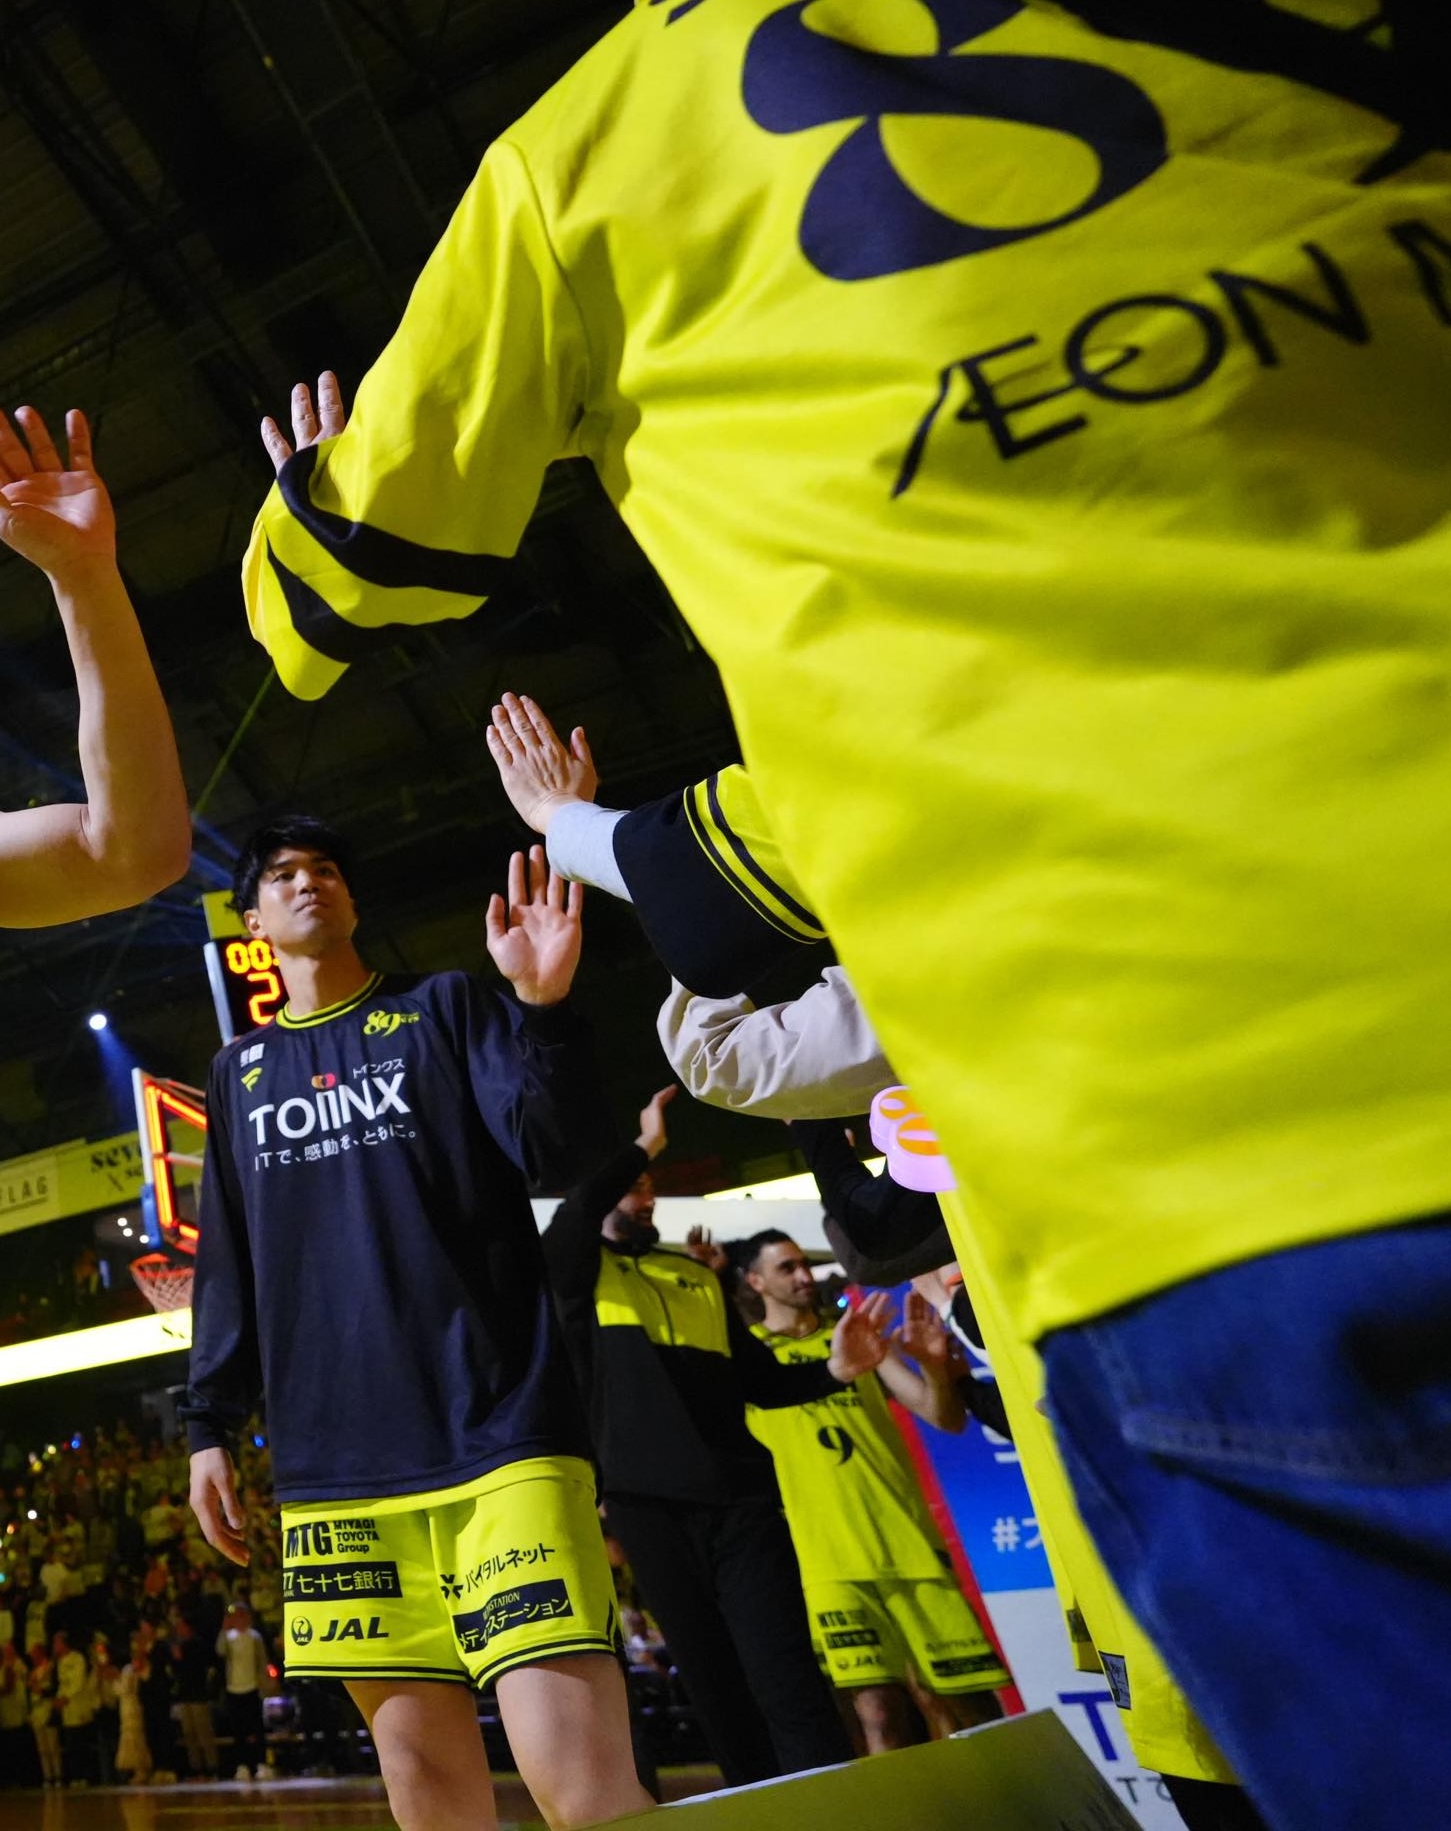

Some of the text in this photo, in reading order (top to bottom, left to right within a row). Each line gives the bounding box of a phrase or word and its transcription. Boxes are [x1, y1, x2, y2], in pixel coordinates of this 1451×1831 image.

[247, 971, 281, 1025] 2
[352, 1058, 405, 1080] トインクス
[818, 1425, 853, 1465] 9
[333, 1519, 375, 1530] MIYAGI
[335, 1530, 380, 1542] TOYOTA
[285, 1522, 334, 1558] MTG
[337, 1543, 370, 1554] Group
[466, 1542, 555, 1593] バイタルネット
[296, 1570, 394, 1594] 七十七銀行
[319, 1616, 389, 1642] JAL
